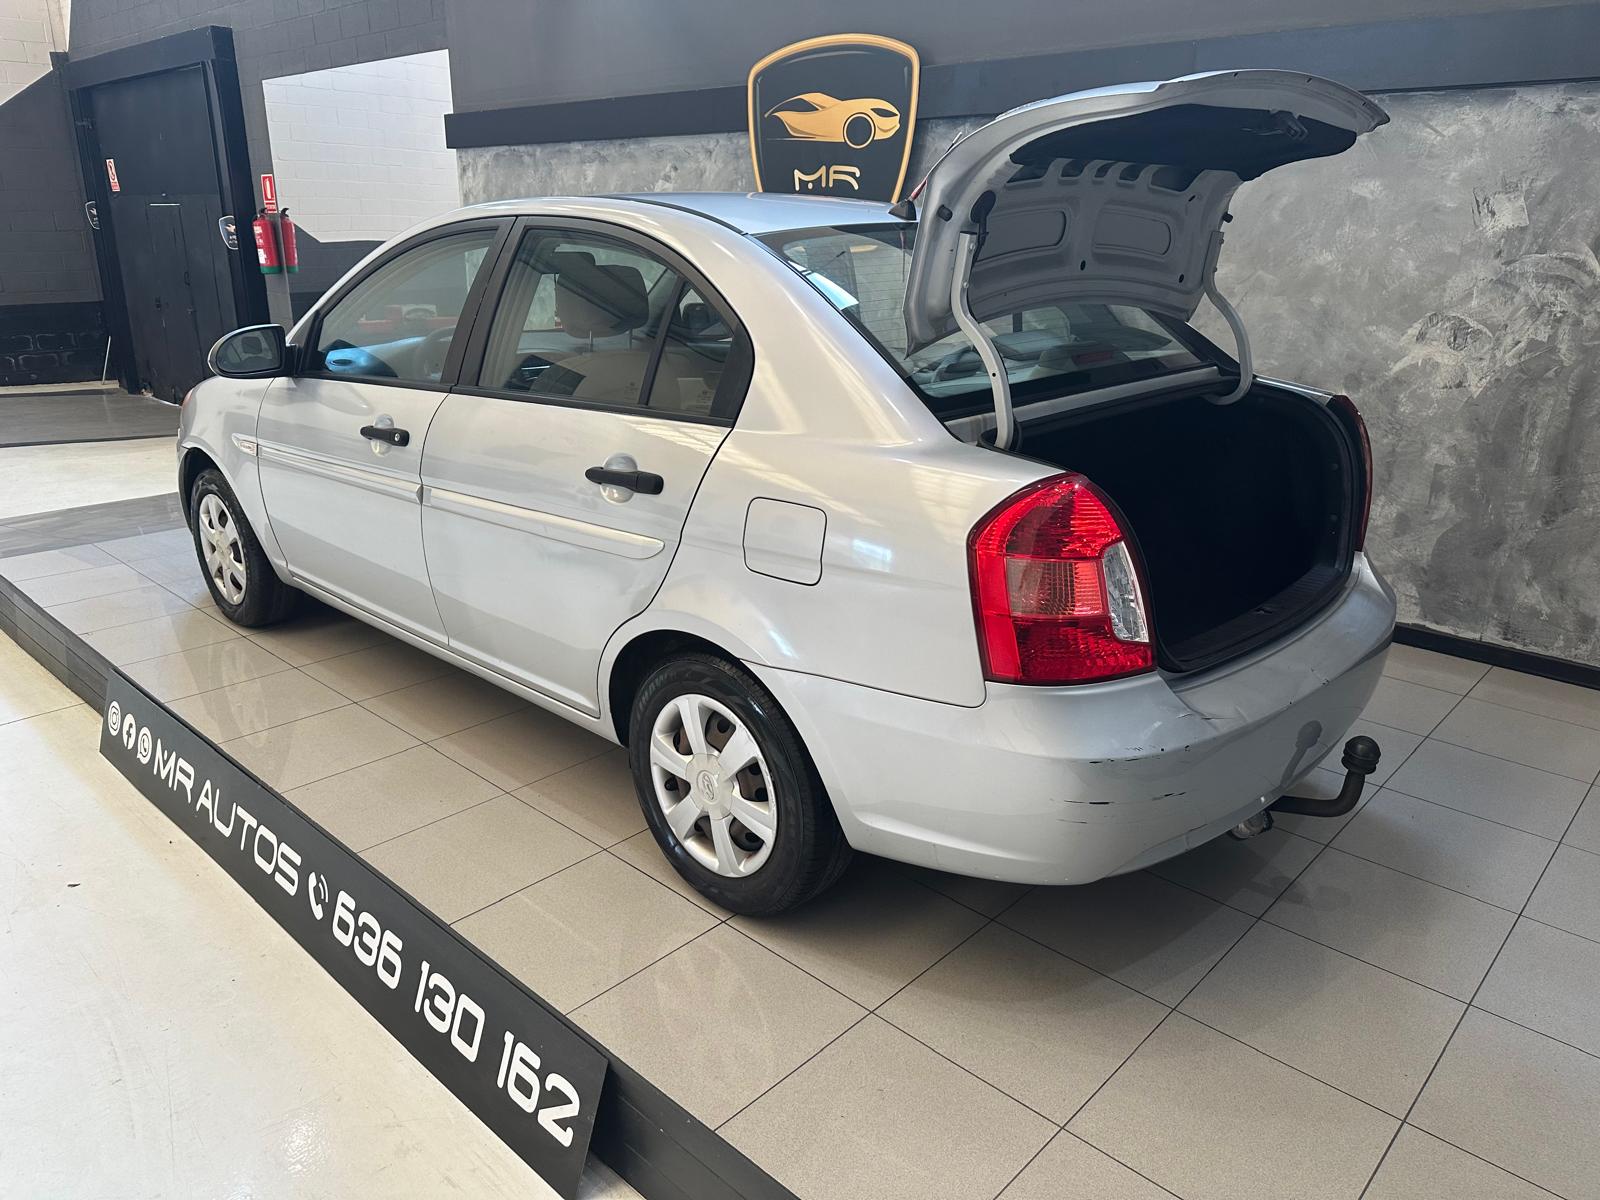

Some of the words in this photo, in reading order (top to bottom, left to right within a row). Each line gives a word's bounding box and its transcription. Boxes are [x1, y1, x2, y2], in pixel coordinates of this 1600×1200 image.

[793, 165, 861, 191] MR
[153, 738, 195, 804] MR
[195, 779, 302, 897] AUTOS
[332, 890, 403, 990] 636
[414, 960, 486, 1063] 130
[496, 1030, 581, 1148] 162
